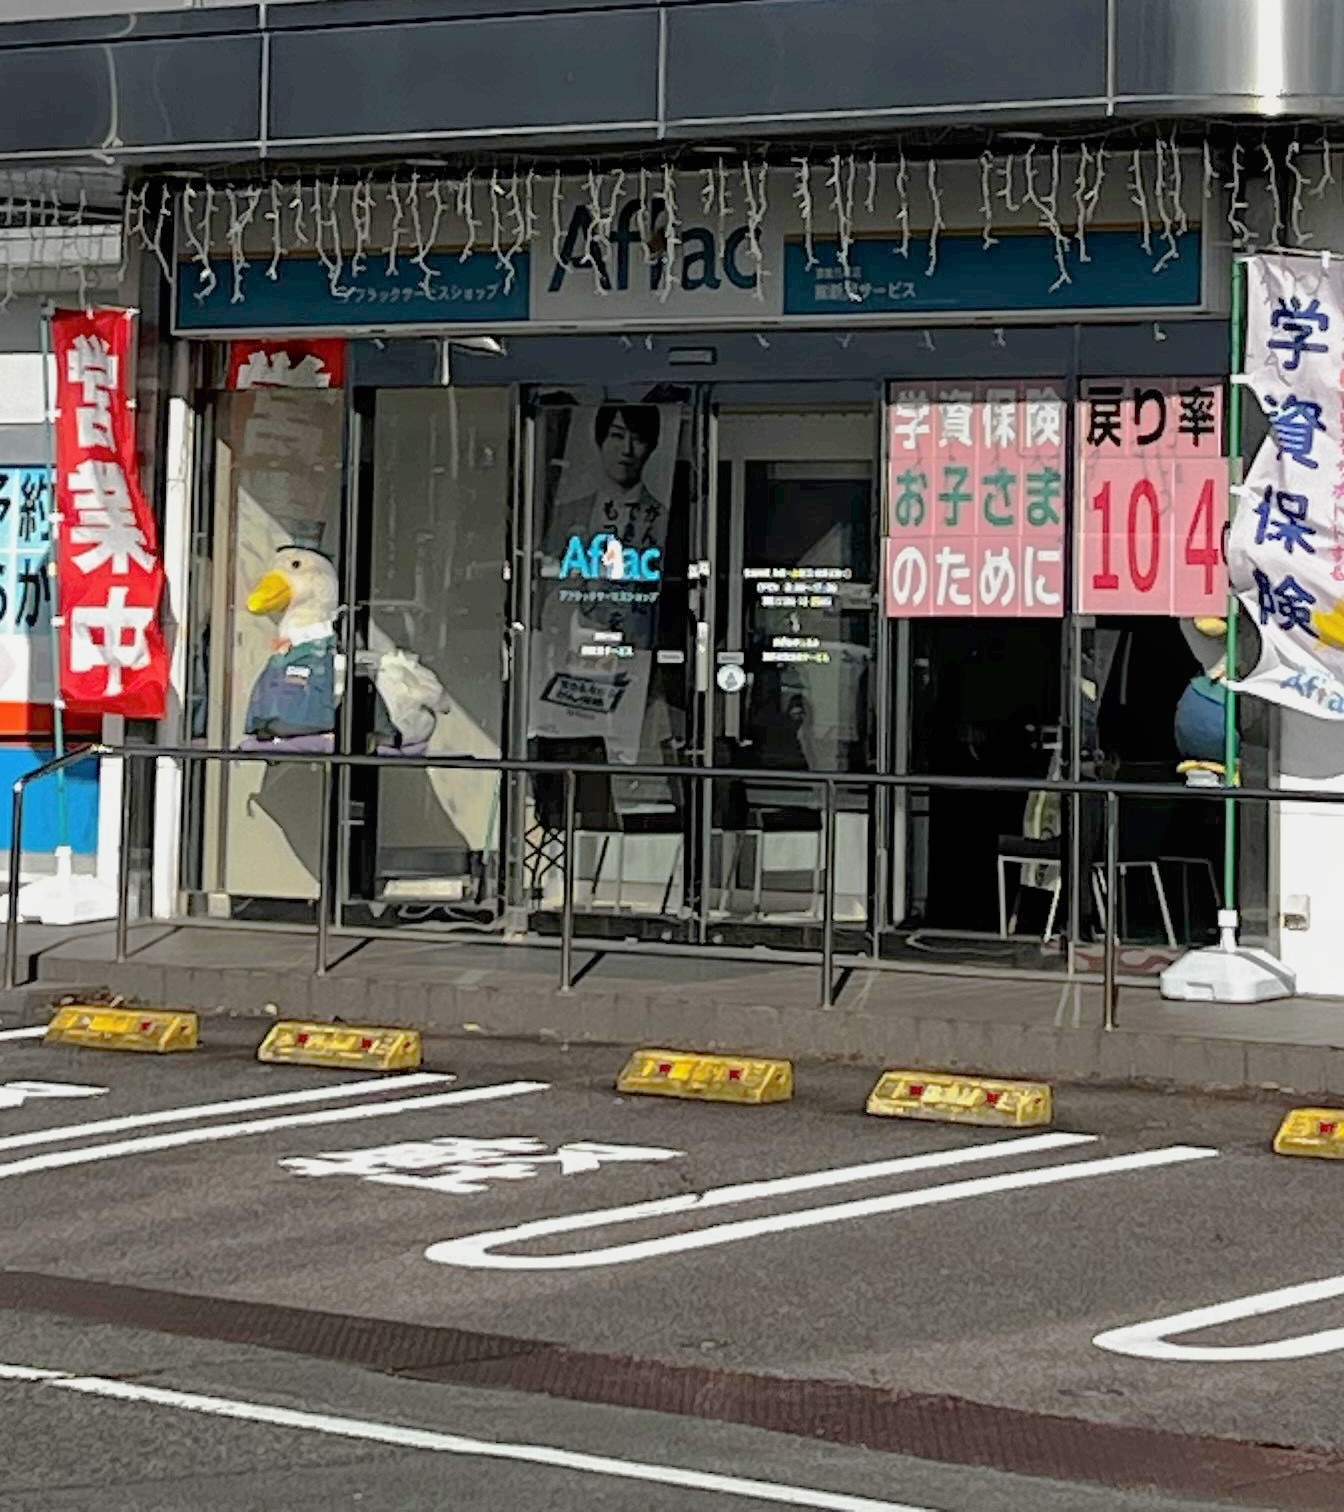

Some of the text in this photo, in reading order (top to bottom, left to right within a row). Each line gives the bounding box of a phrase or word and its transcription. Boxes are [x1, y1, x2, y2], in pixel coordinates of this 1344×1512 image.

[548, 196, 762, 293] Aflac
[894, 388, 1062, 449] 学資保険
[1087, 386, 1216, 448] 戻り率
[894, 465, 1061, 528] お子さま
[1251, 296, 1330, 640] 学資保険
[67, 333, 156, 695] 営業中
[558, 533, 661, 581] Aflac
[892, 545, 1062, 607] のために
